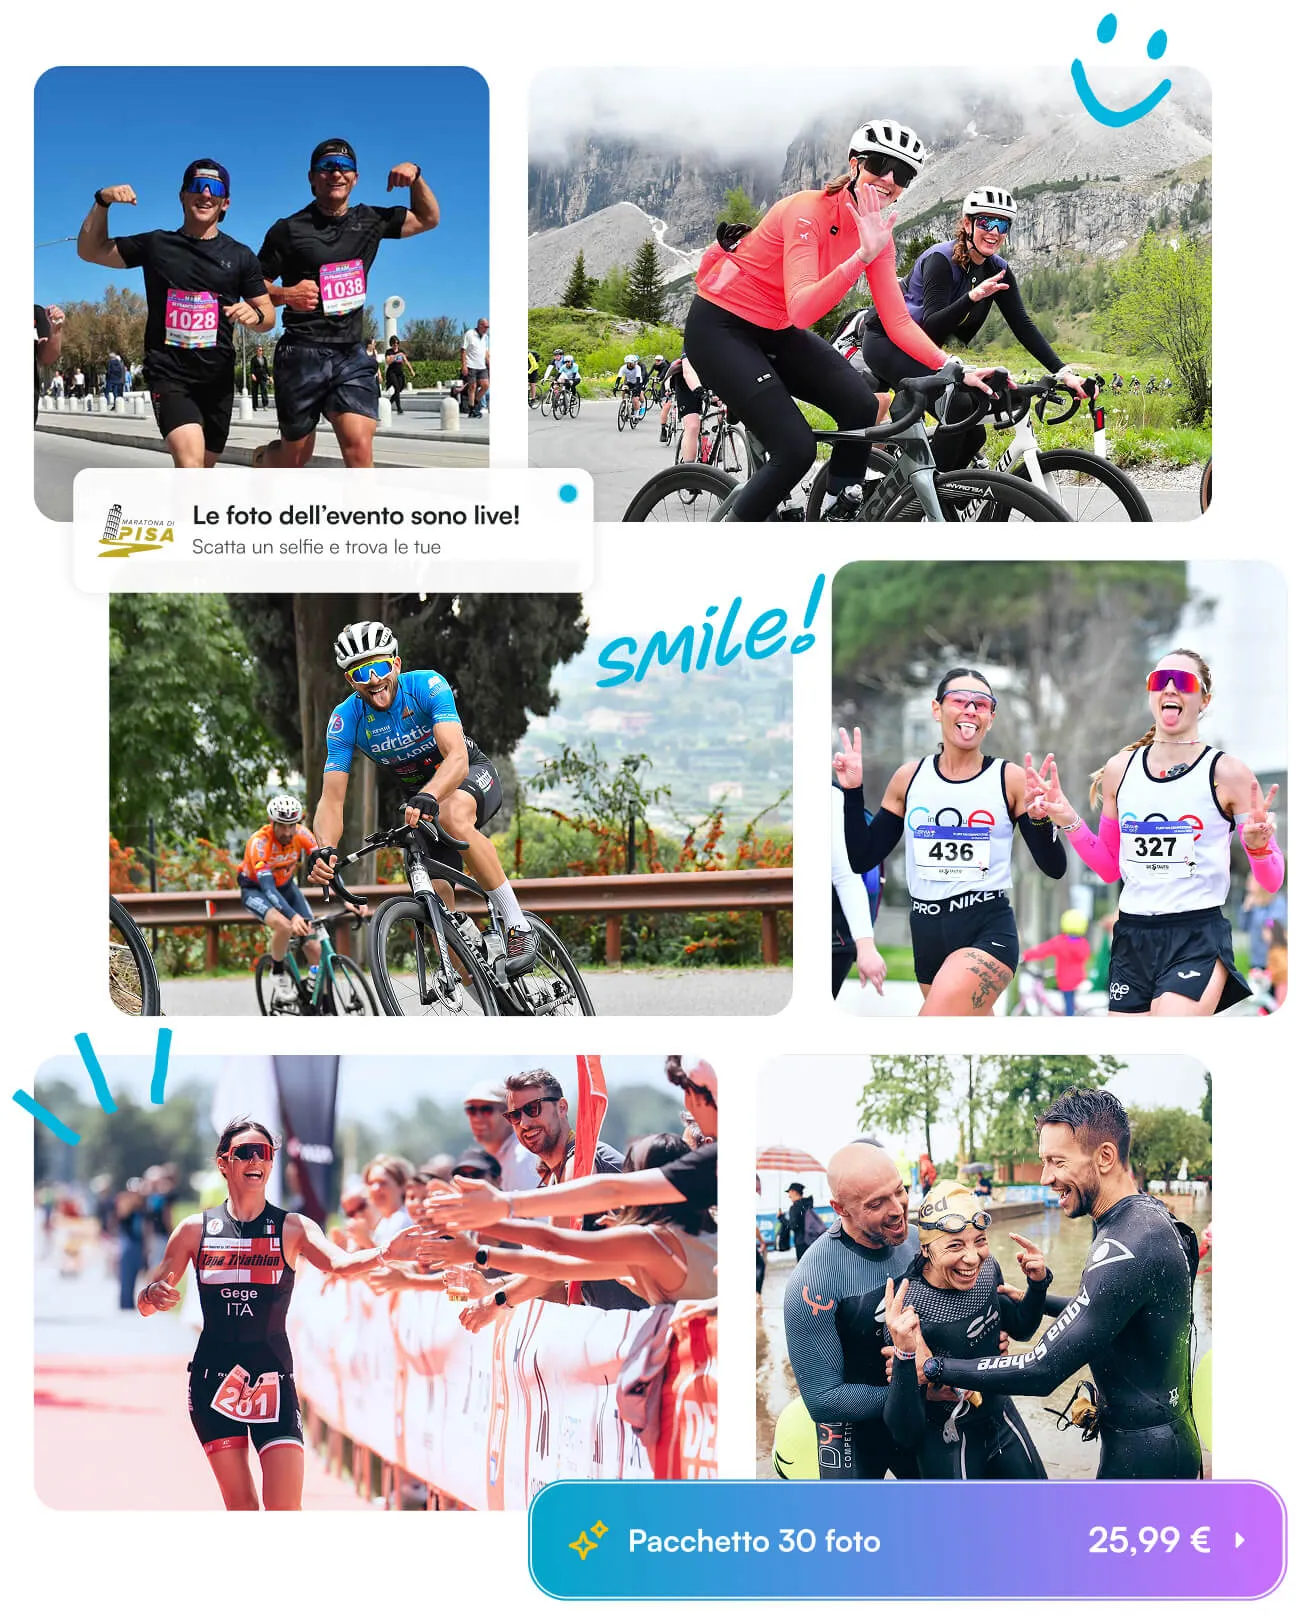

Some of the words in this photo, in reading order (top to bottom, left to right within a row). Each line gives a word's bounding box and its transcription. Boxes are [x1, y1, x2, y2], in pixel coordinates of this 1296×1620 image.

[323, 278, 363, 299] 1038
[169, 310, 216, 329] 1028
[371, 725, 432, 753] adriatic
[928, 842, 974, 862] 436
[1134, 837, 1177, 857] 327
[949, 890, 996, 912] NIKE
[228, 1254, 280, 1266] Triathlon
[220, 1287, 258, 1301] Gege
[226, 1302, 254, 1317] ITA
[1046, 1284, 1091, 1342] Aqua
[219, 1387, 268, 1416] 201
